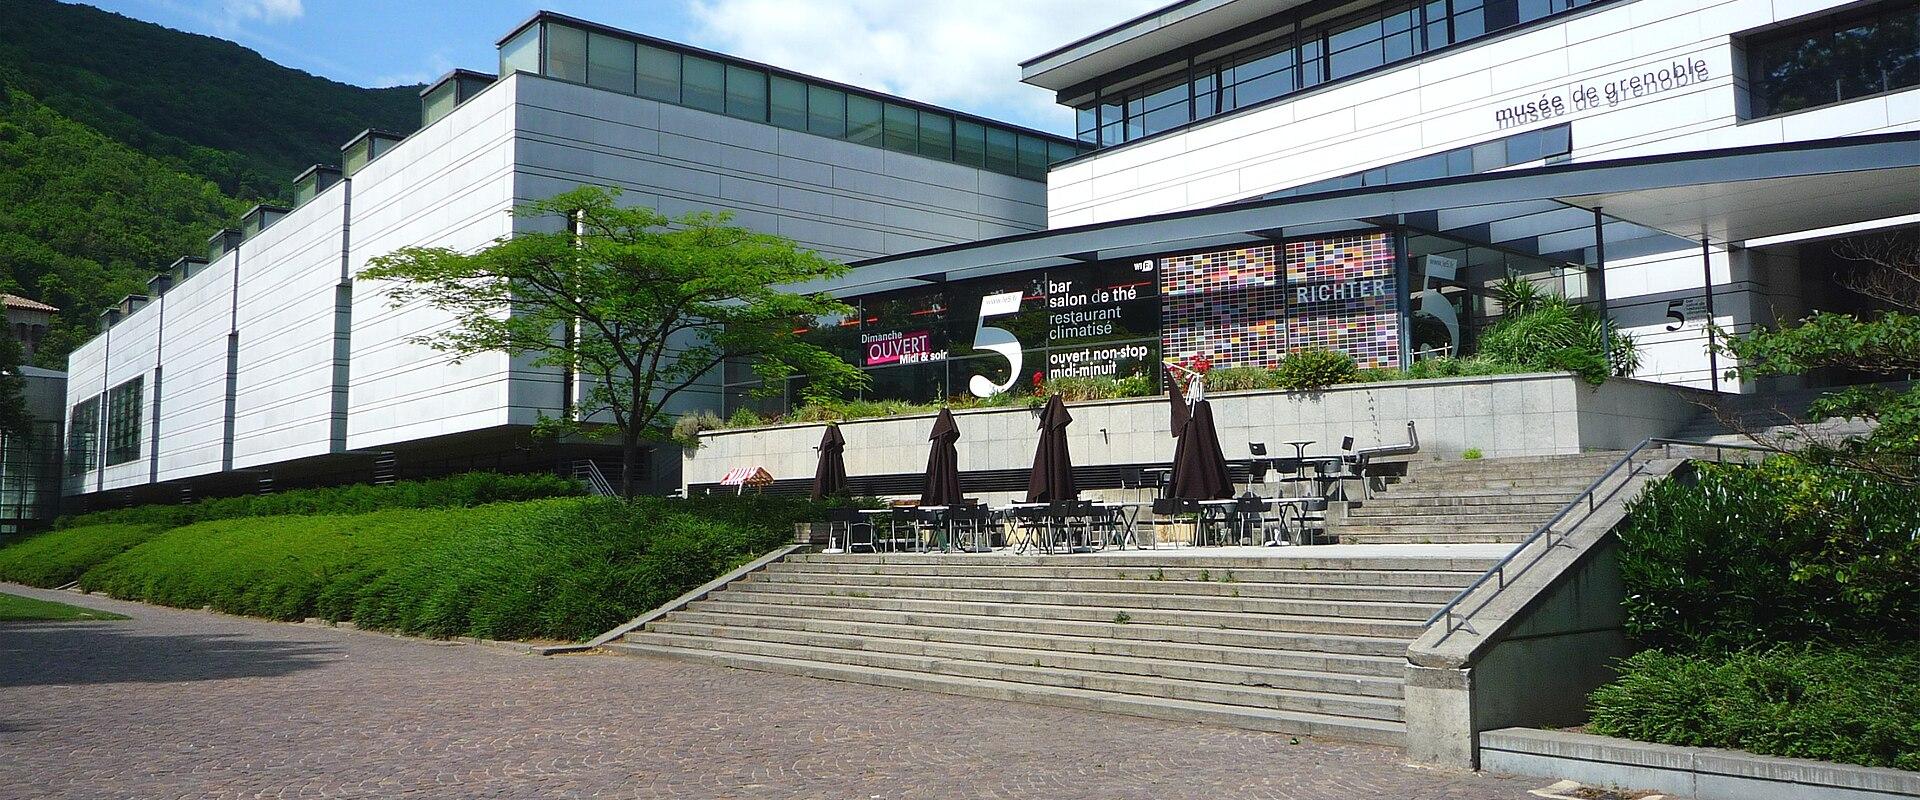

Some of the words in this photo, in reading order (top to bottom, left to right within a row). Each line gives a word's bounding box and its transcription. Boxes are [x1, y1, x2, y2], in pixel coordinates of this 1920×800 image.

[1495, 94, 1562, 122] musée
[1572, 84, 1598, 103] de
[1604, 57, 1707, 99] grenoble
[1049, 280, 1073, 294] bar
[1049, 293, 1087, 308] salon
[1091, 289, 1110, 304] de
[1112, 285, 1137, 302] thé
[1296, 279, 1386, 304] RICHTER
[1050, 305, 1122, 325] restaurant
[1666, 299, 1685, 331] 5
[861, 330, 903, 344] Dimanche
[1049, 320, 1113, 340] climatisé
[869, 335, 927, 360] OUVERT
[969, 290, 1024, 398] 5
[1050, 348, 1090, 365] ouvert
[1094, 344, 1148, 361] non-stop
[900, 353, 919, 365] Midi
[920, 351, 929, 362] &
[930, 349, 948, 361] soir
[1050, 360, 1117, 379] midi-minuit
